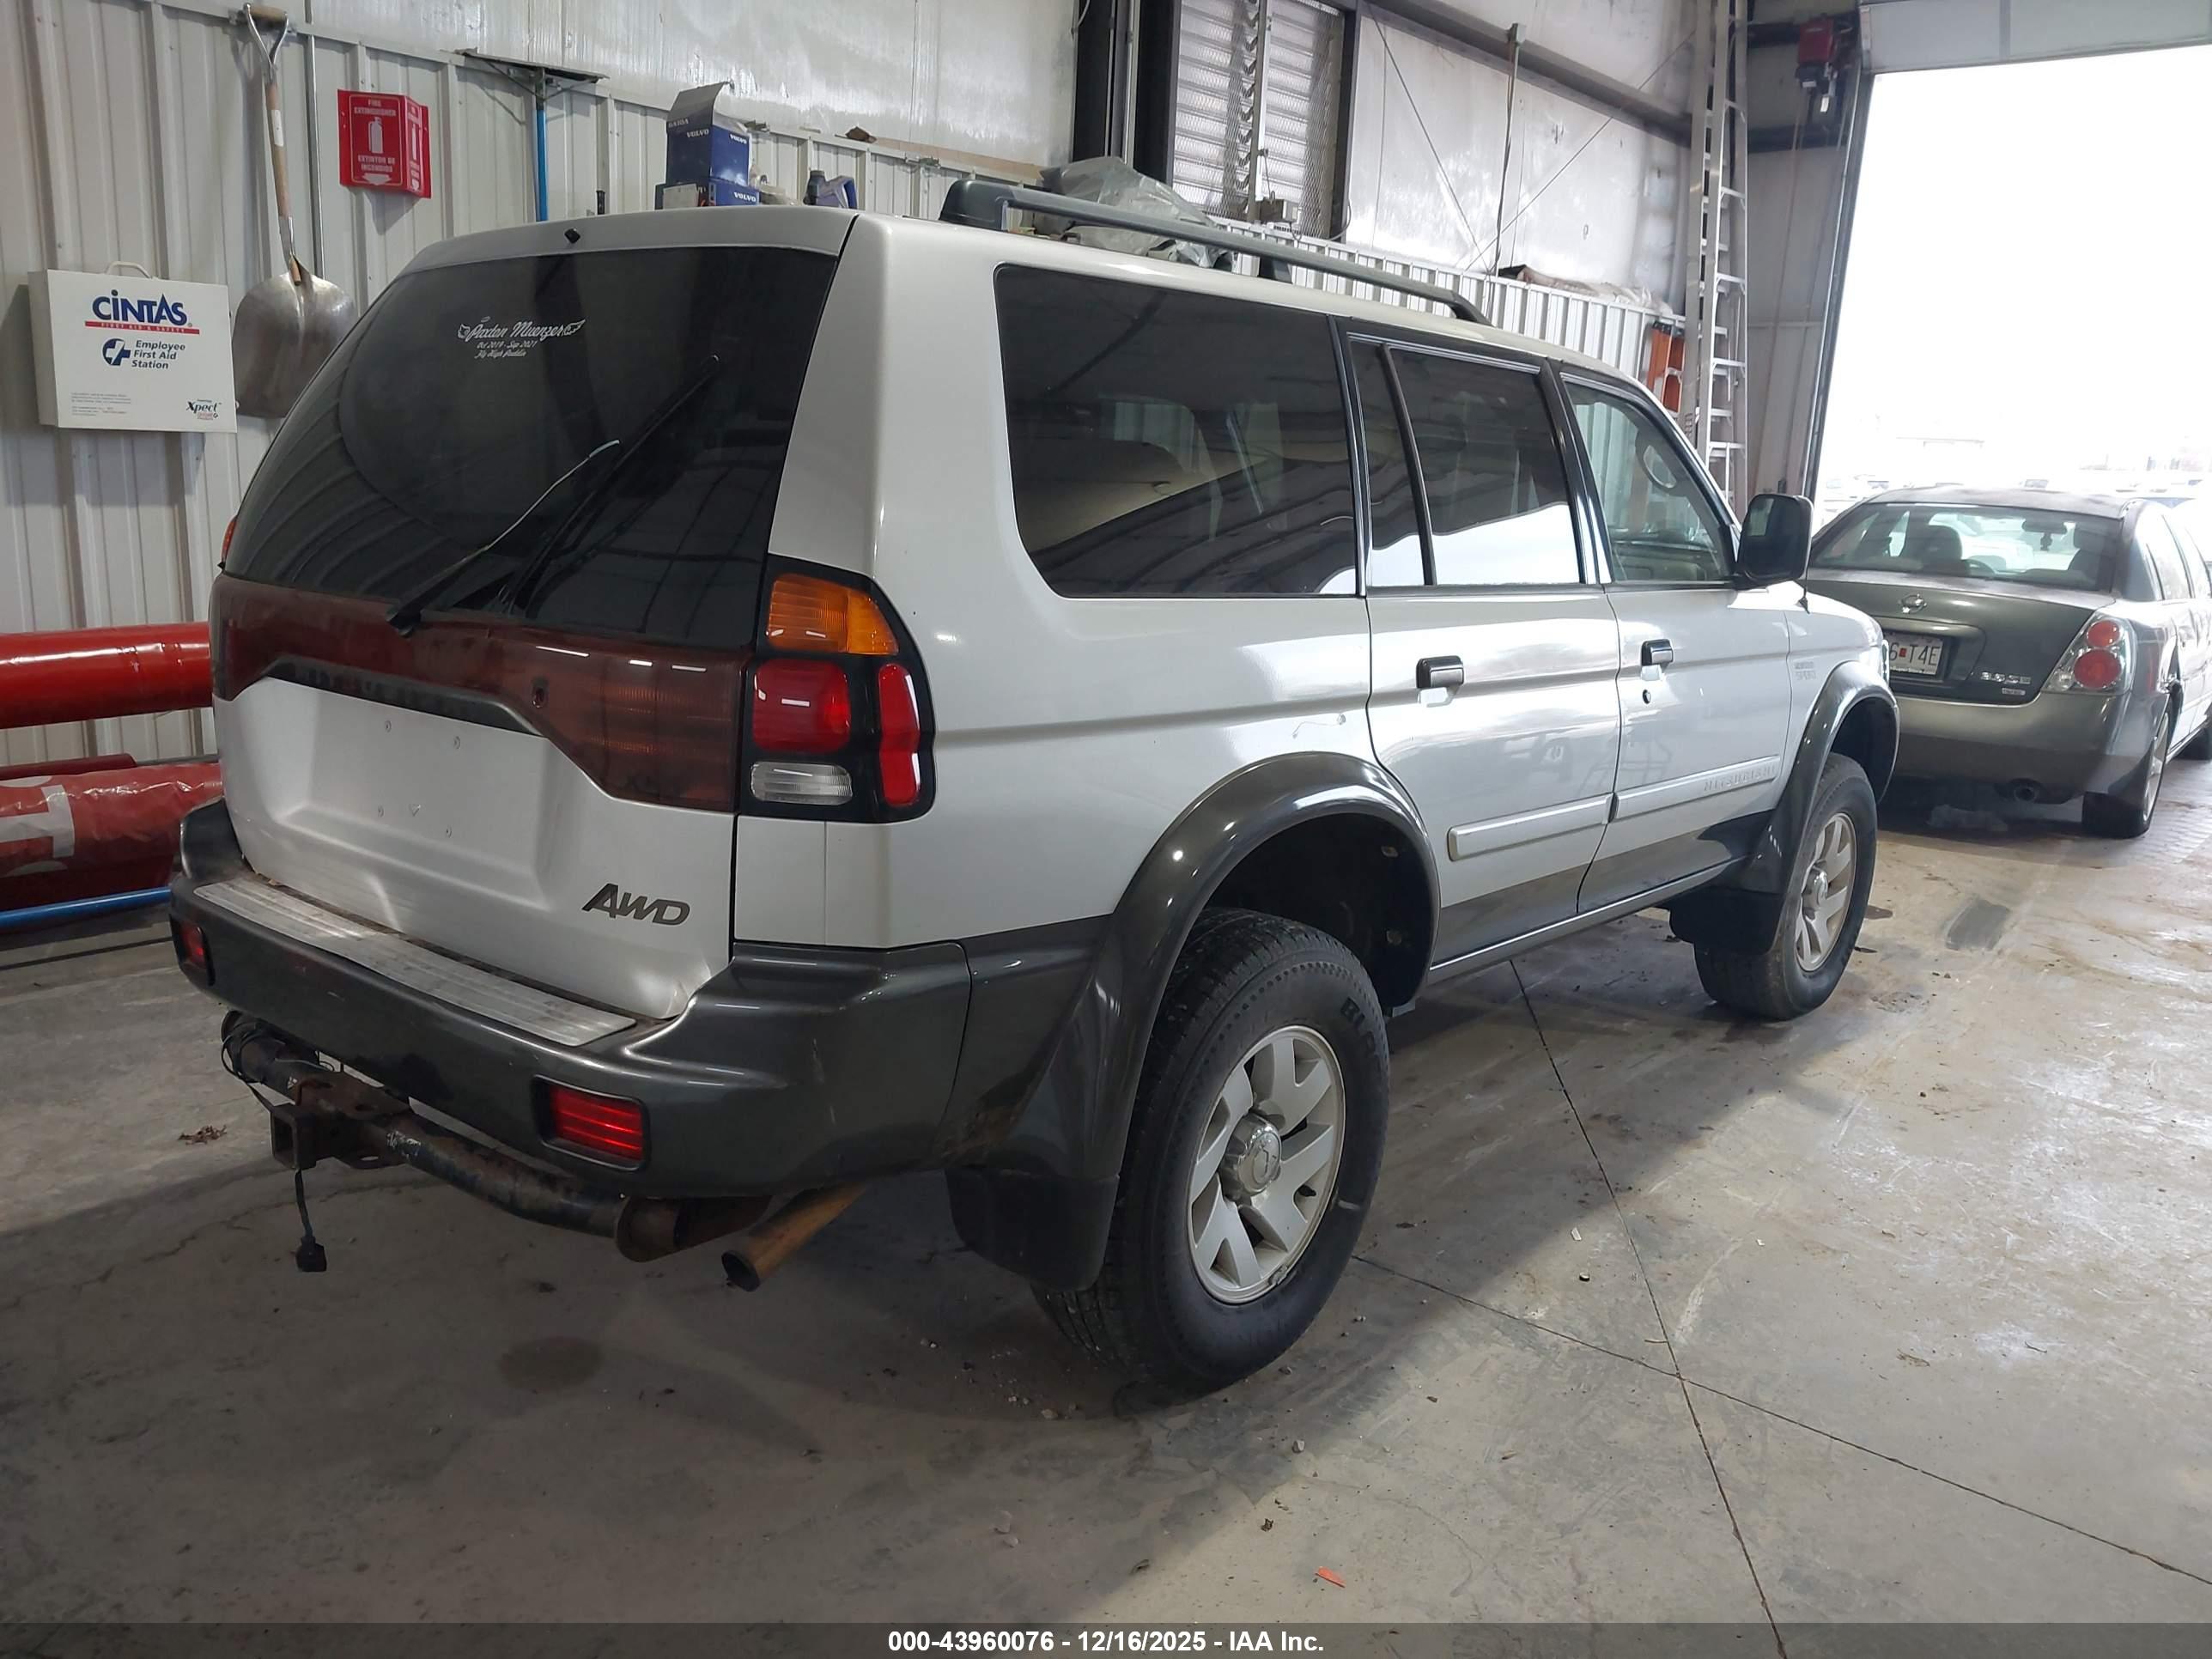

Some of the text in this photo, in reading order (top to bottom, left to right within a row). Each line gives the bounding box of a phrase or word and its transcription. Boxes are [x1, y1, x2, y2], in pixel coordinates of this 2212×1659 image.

[687, 129, 709, 137] VOLVO
[730, 134, 747, 144] VOLVO
[734, 191, 757, 203] VOLVO
[136, 340, 185, 352] Employee
[134, 349, 177, 360] First Aid
[131, 360, 169, 370] Station
[1909, 643, 1940, 666] T4E
[581, 883, 690, 926] AWD
